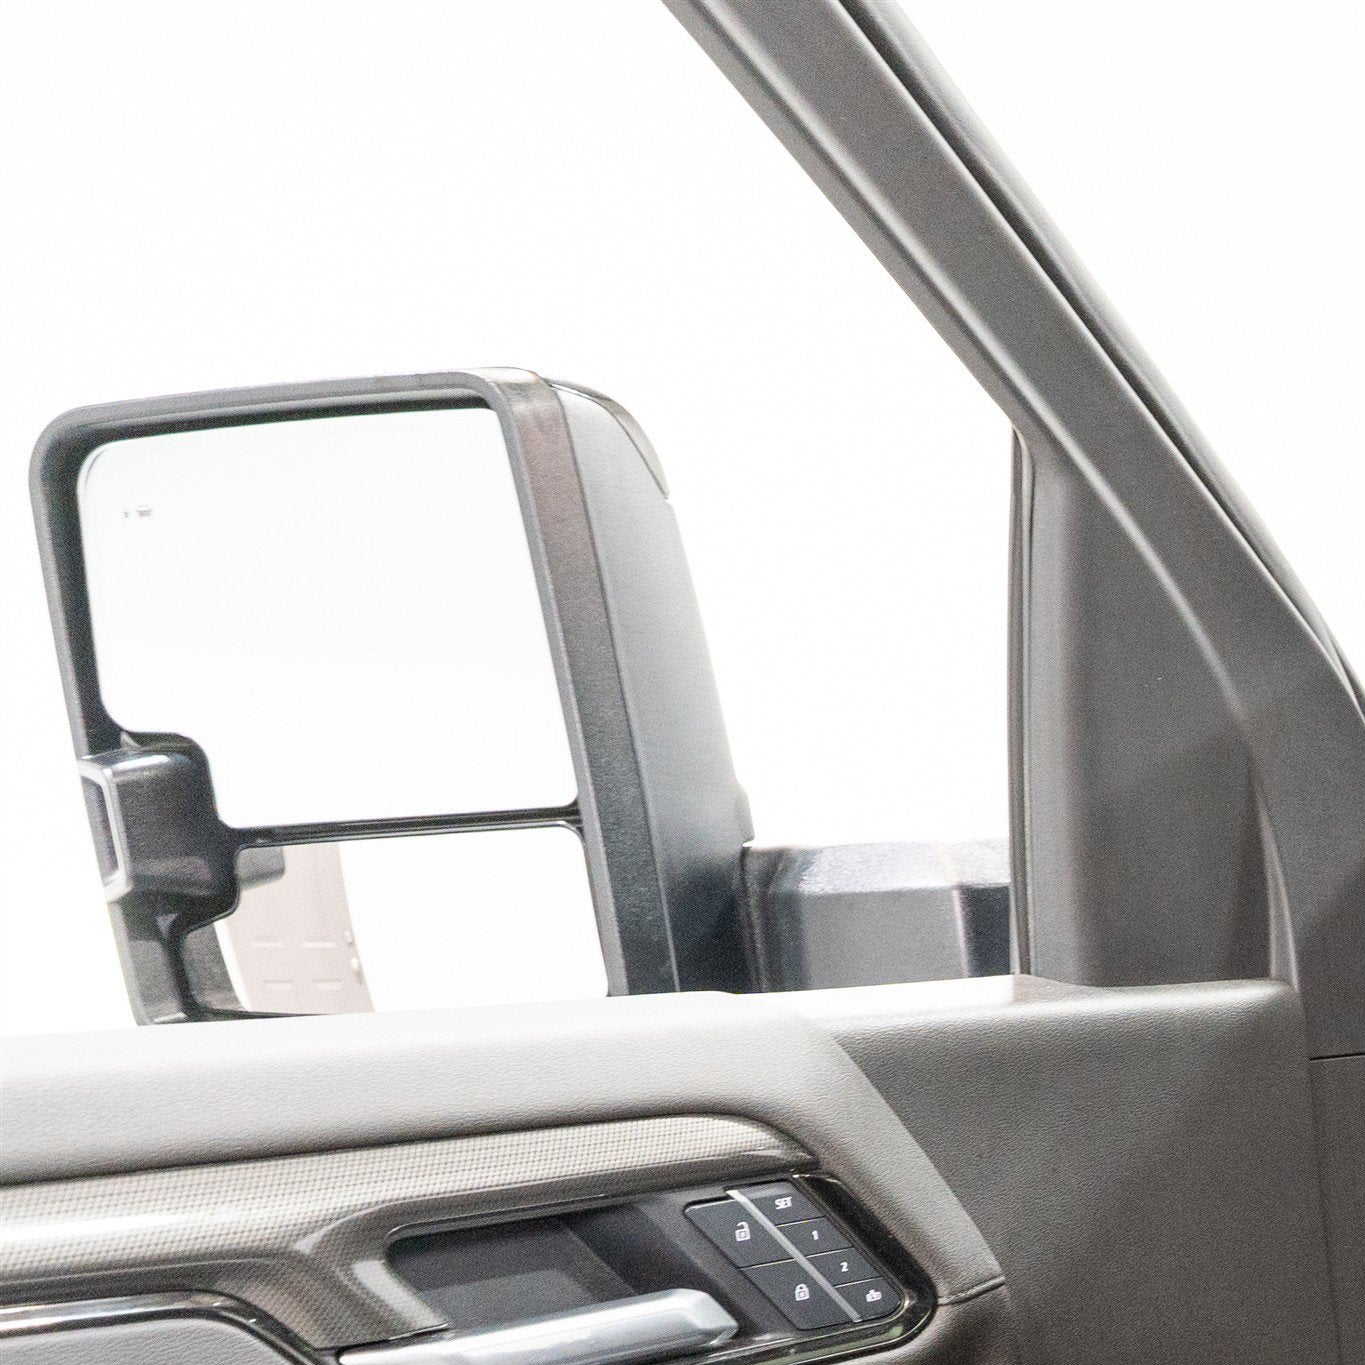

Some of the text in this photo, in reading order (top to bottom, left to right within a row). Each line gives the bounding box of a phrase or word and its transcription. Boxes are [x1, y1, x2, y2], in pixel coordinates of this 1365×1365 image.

[775, 1197, 793, 1210] SET
[811, 1230, 819, 1241] 1
[840, 1261, 849, 1272] 2
